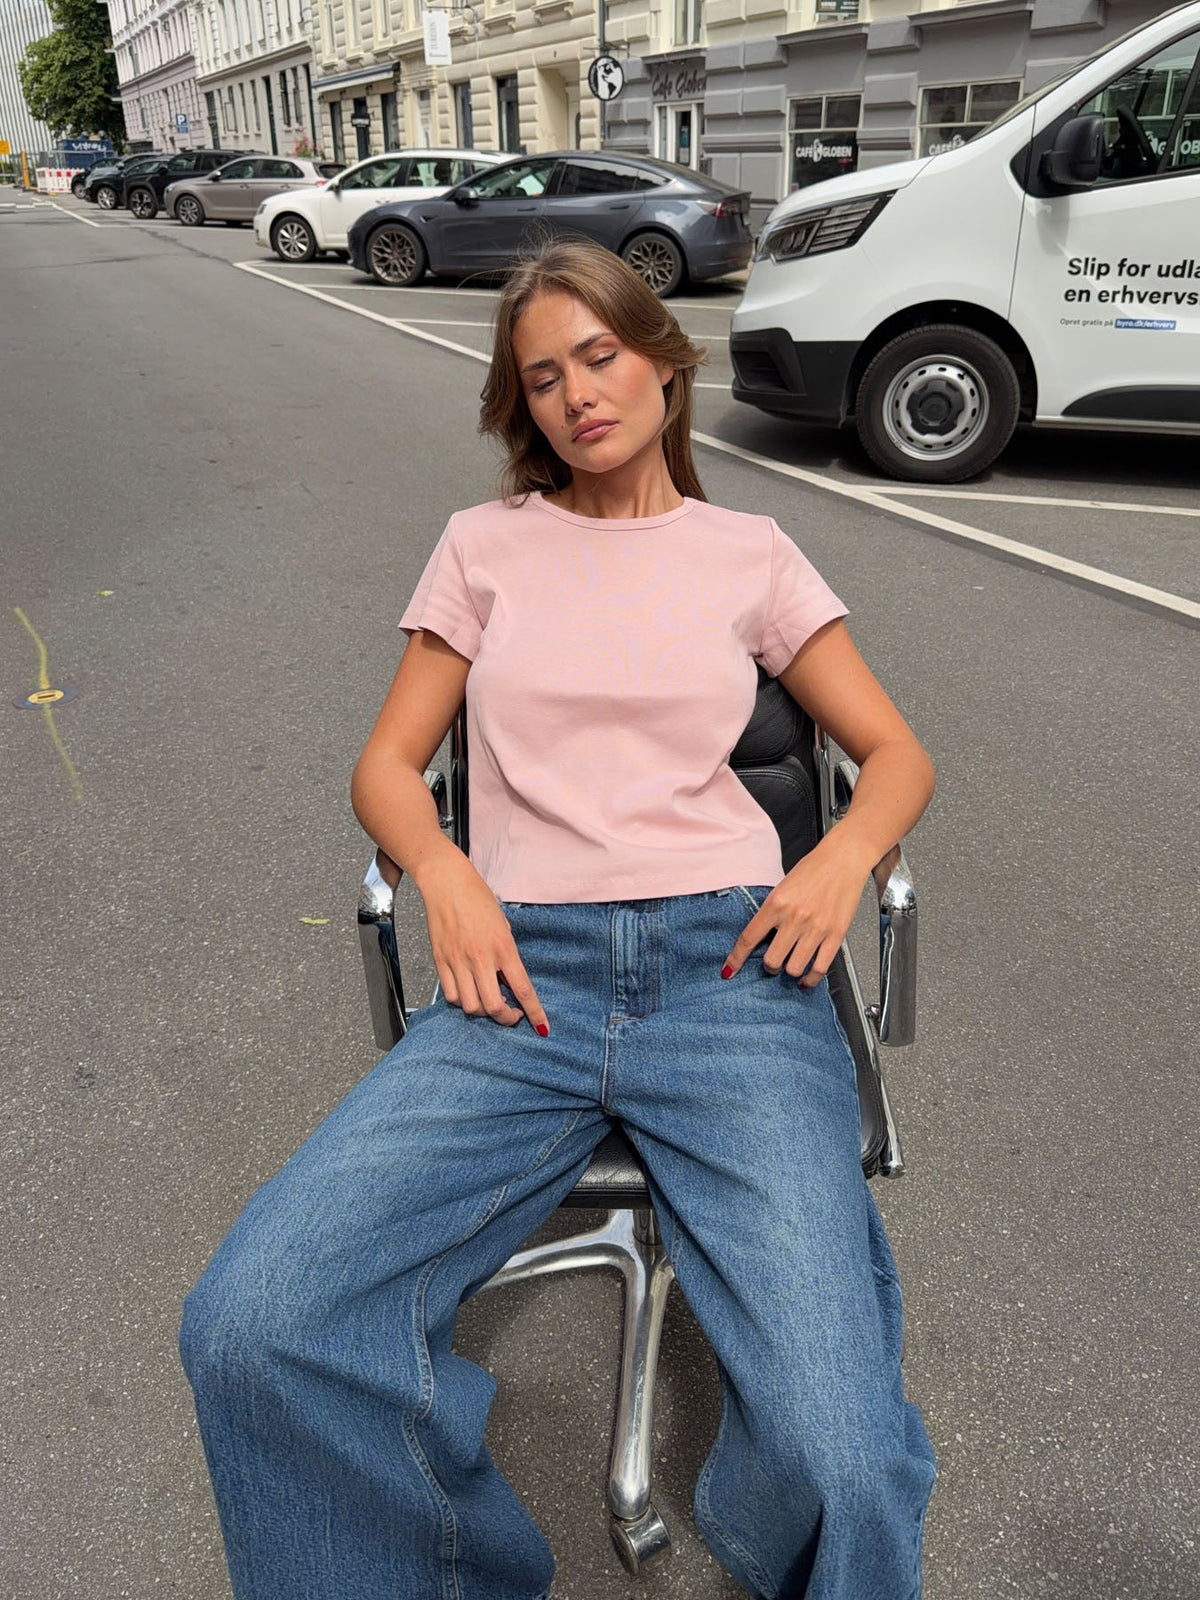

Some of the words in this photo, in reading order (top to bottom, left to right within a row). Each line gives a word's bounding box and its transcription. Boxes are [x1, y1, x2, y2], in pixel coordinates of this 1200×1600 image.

[177, 115, 185, 125] P
[822, 145, 852, 158] GLOBEN
[1067, 257, 1110, 280] Slip
[1117, 258, 1151, 278] for
[1063, 288, 1091, 303] en
[1097, 285, 1199, 305] erhvervs
[1060, 318, 1080, 326] Opret
[1082, 319, 1103, 328] gratis
[1104, 319, 1114, 328] på
